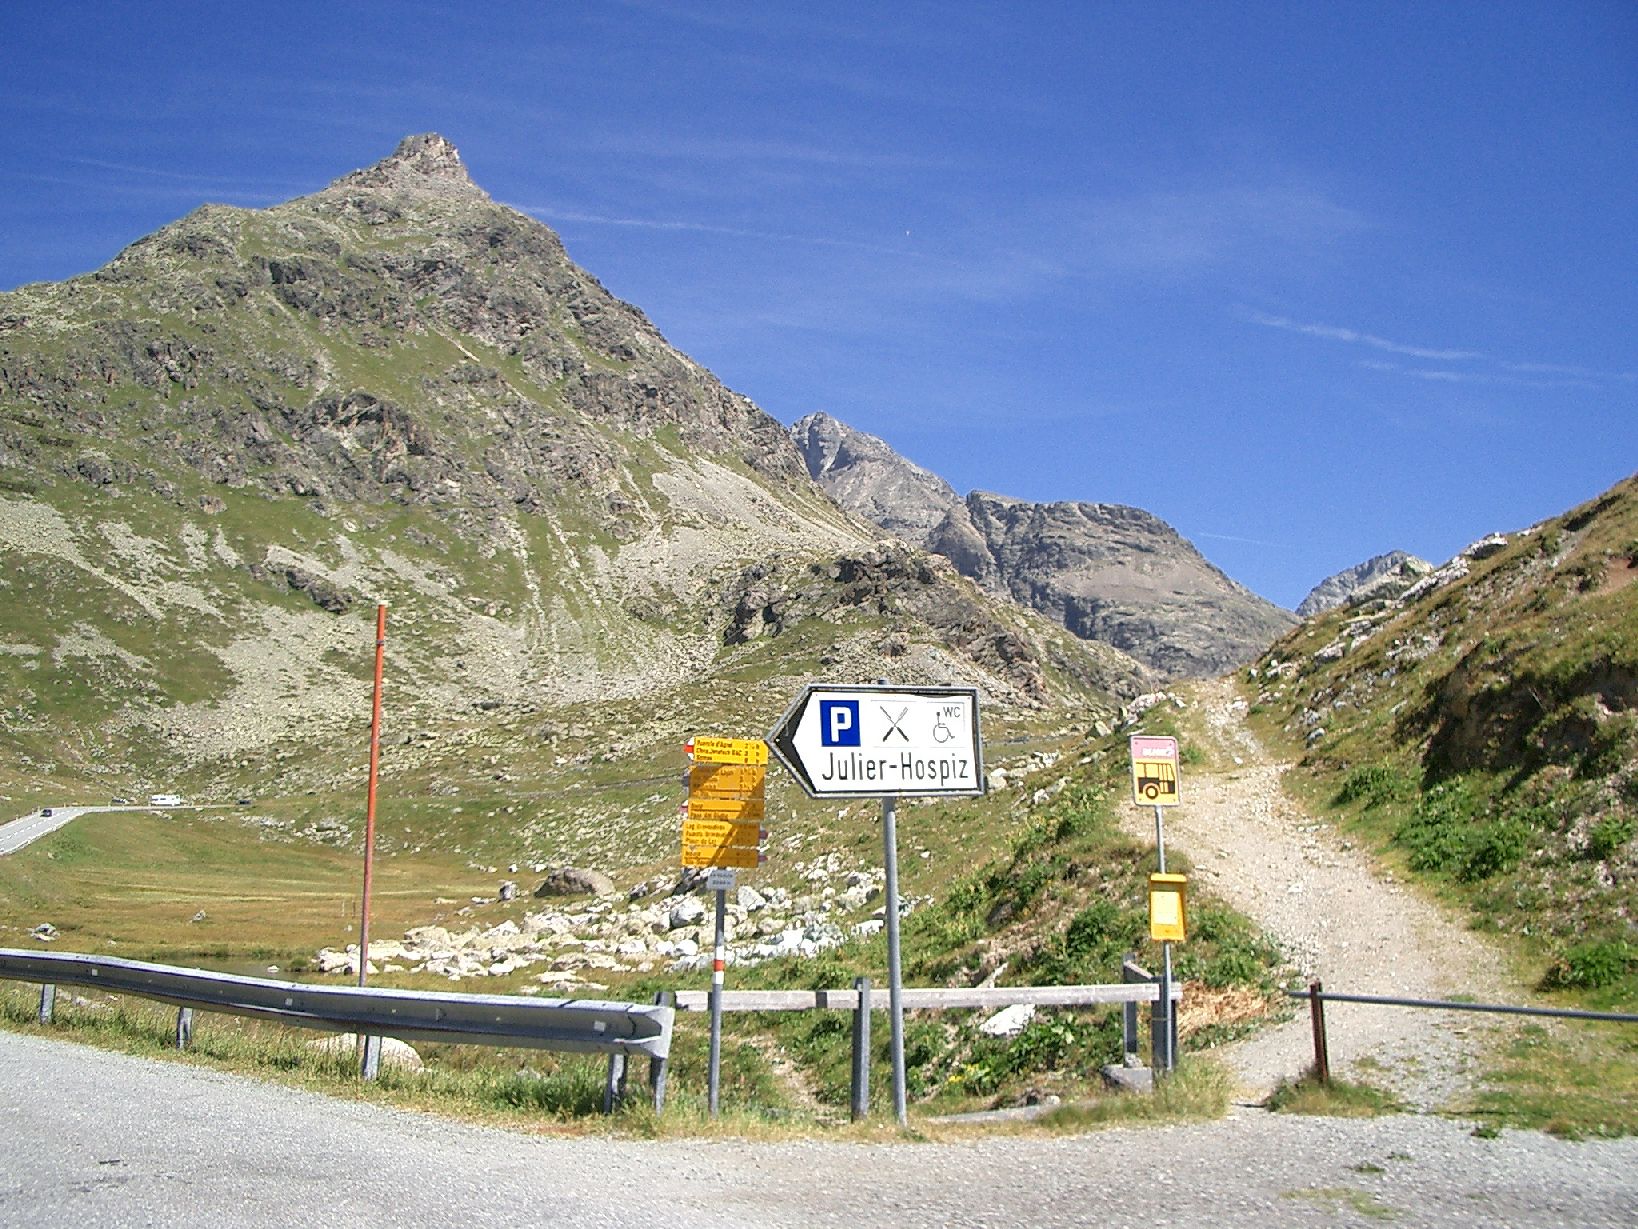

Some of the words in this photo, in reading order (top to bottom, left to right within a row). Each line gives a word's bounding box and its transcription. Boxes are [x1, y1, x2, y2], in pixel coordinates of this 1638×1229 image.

[830, 706, 852, 742] P
[943, 706, 961, 718] WC
[822, 752, 969, 786] Julier-Hospiz
